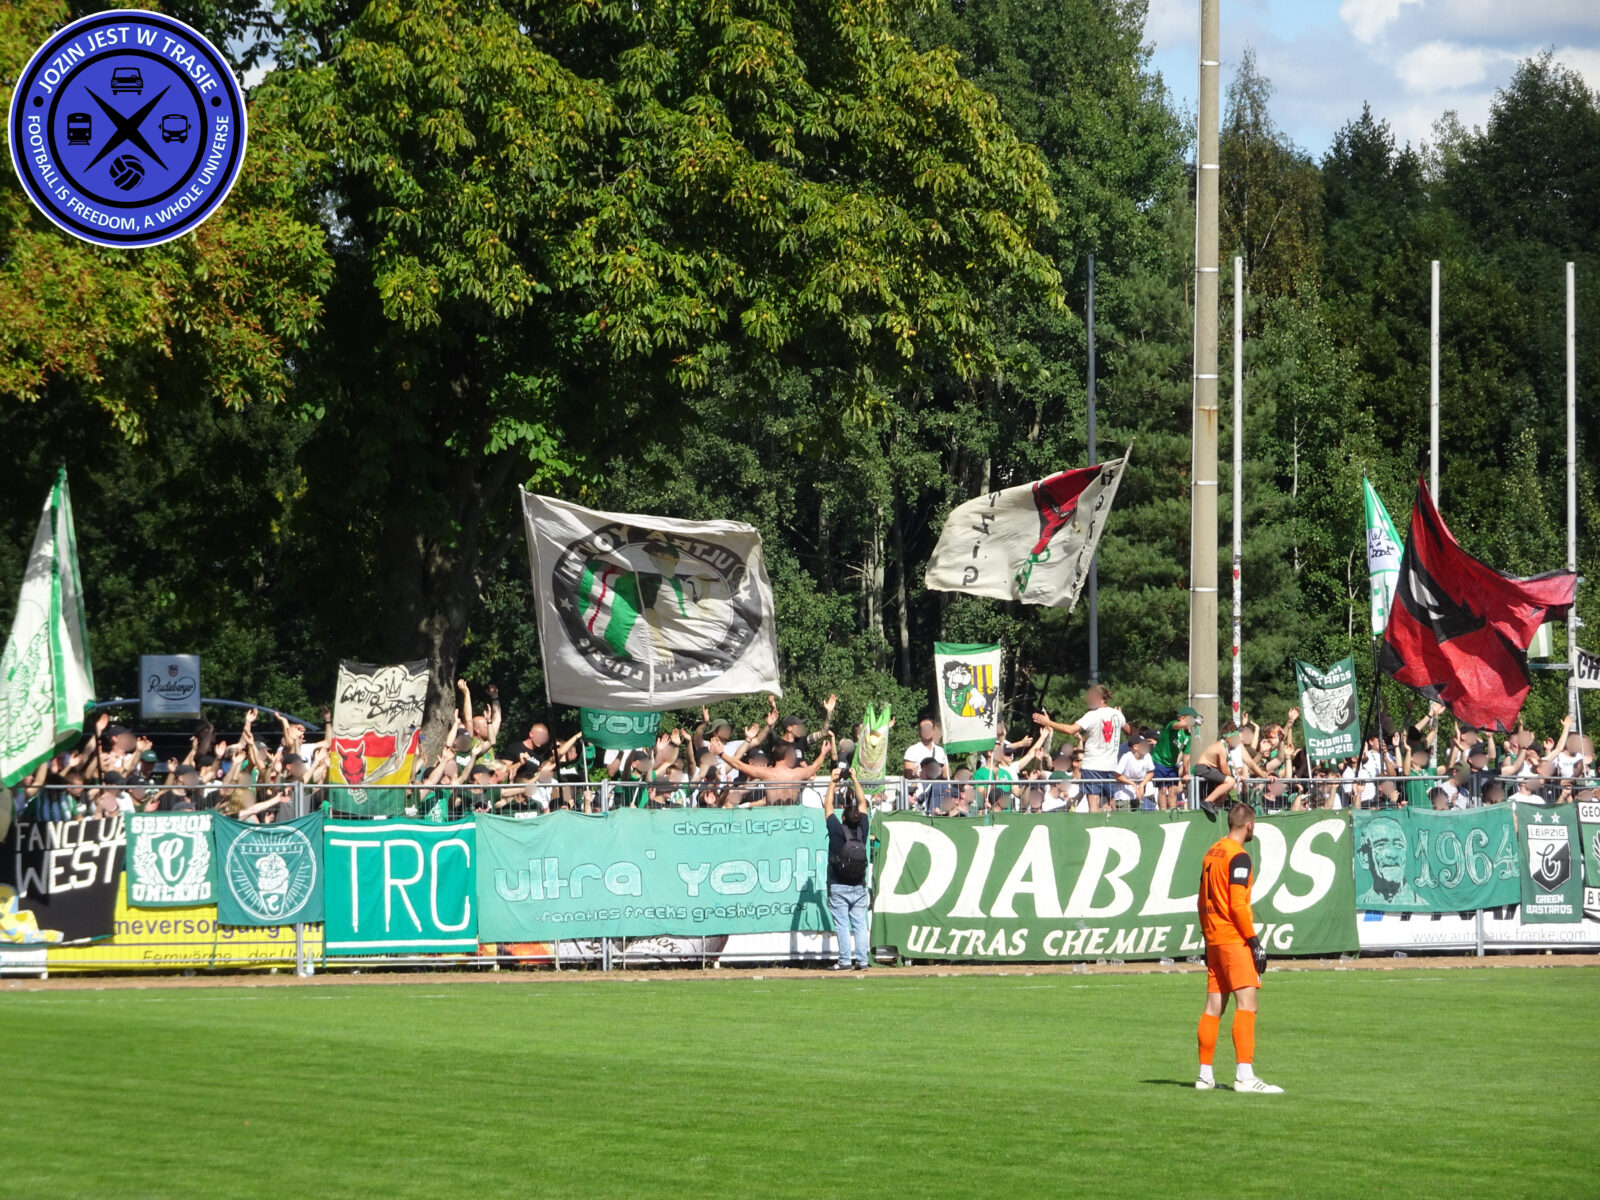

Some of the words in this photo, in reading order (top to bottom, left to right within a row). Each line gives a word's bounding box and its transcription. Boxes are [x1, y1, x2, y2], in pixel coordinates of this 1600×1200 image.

[131, 814, 213, 834] SEKTION
[1530, 827, 1566, 838] LEIPZIG
[16, 838, 127, 898] WEST
[1413, 823, 1521, 889] 1964
[132, 881, 212, 902] UMLAND
[330, 838, 471, 933] TRC
[907, 926, 1028, 956] ULTRAS
[1043, 924, 1169, 955] CHEMIE
